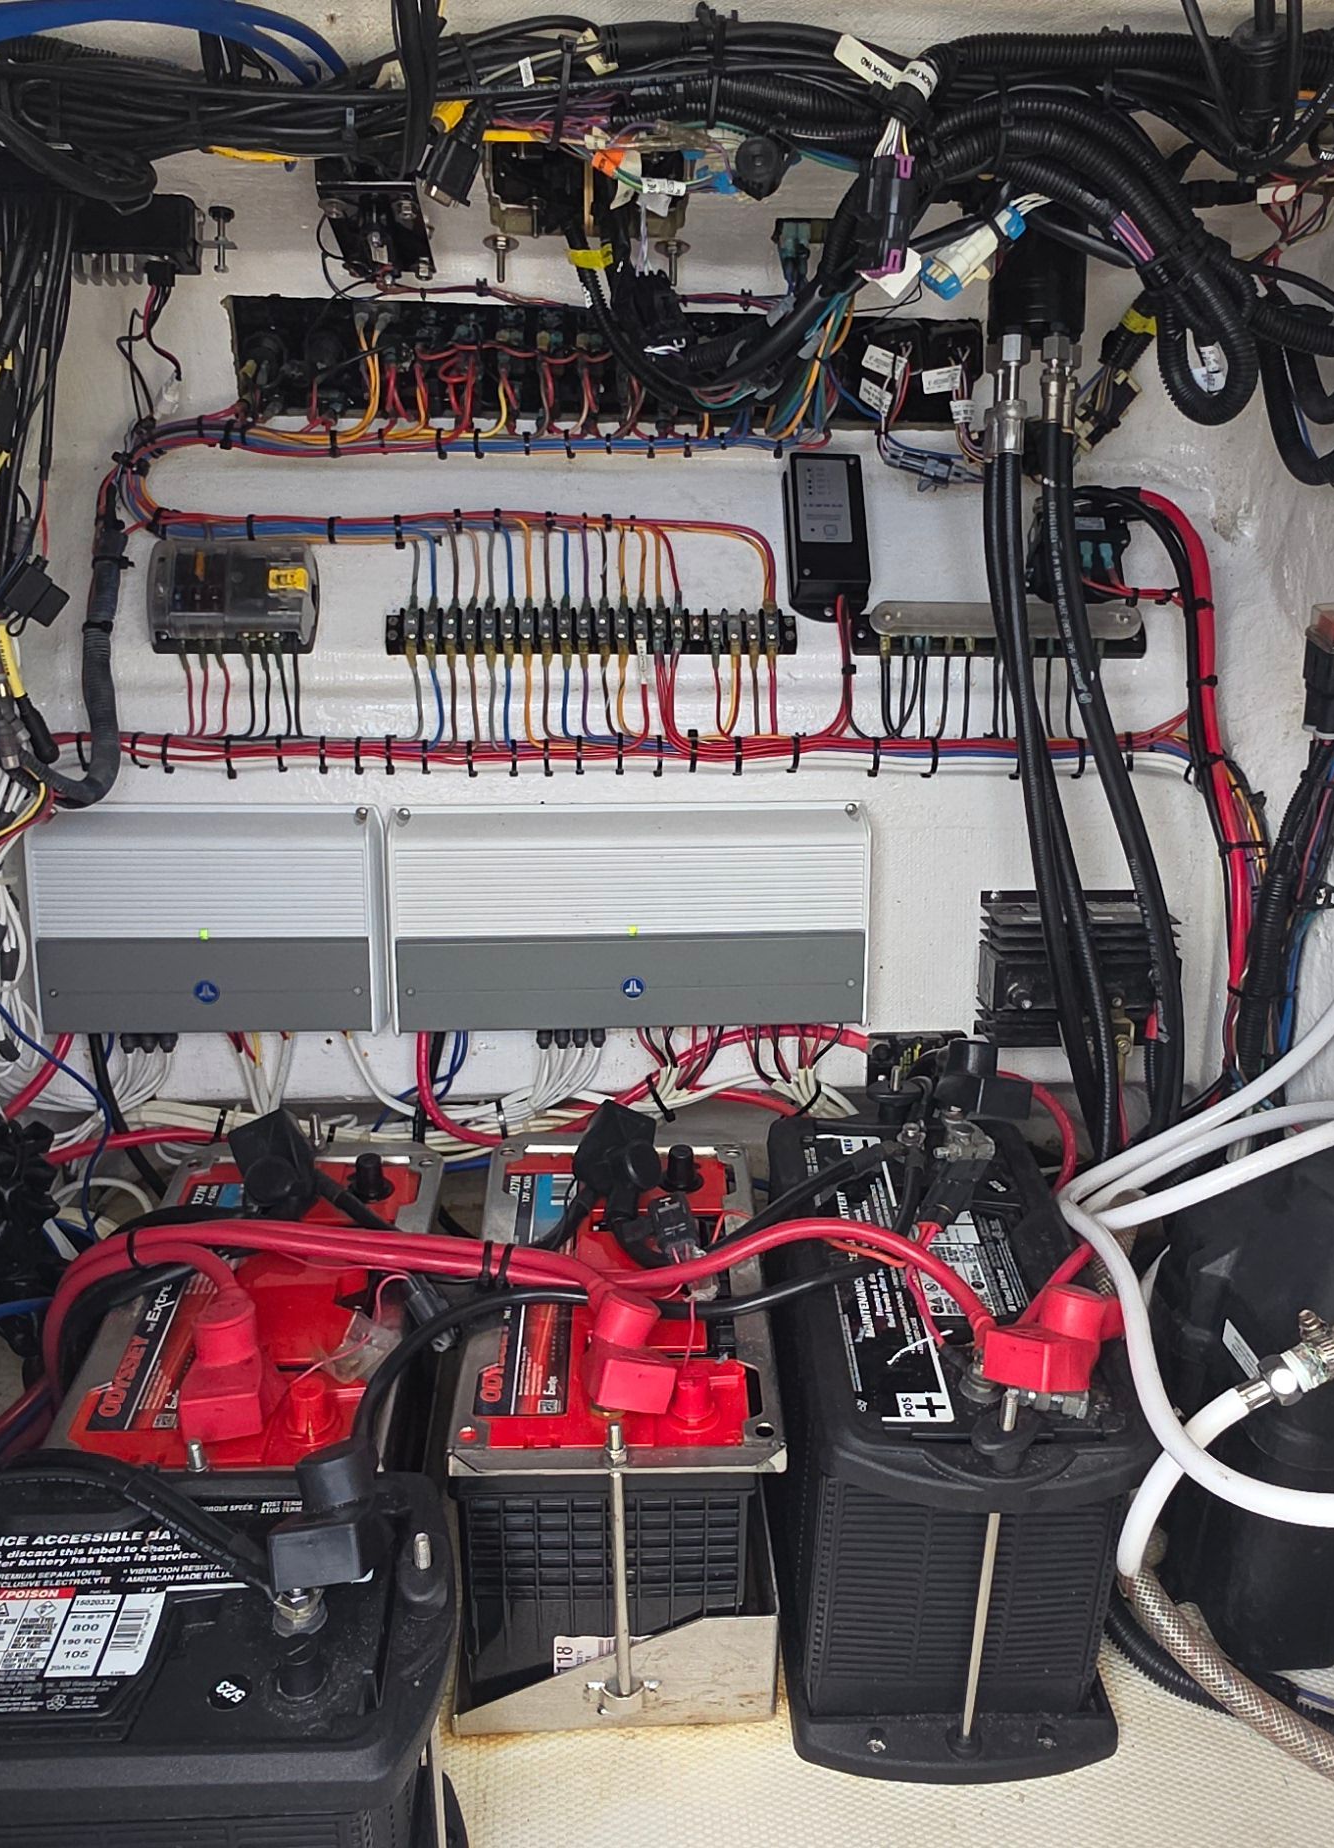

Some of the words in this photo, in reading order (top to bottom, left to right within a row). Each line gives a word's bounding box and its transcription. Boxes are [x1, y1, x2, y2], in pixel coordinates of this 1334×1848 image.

[901, 1397, 915, 1417] POS
[32, 1530, 144, 1546] ACCESSIBLE
[6, 1547, 56, 1558] discard
[59, 1546, 84, 1555] this
[88, 1544, 121, 1555] label
[124, 1544, 138, 1553] to
[141, 1542, 182, 1553] check
[18, 1555, 67, 1567] battery
[70, 1555, 94, 1565] has
[97, 1553, 131, 1563] been
[133, 1552, 147, 1562] in
[38, 1569, 102, 1579] SEPARATORS
[129, 1566, 180, 1575] VIBRATION
[43, 1576, 112, 1587] ELECTROLYTE
[125, 1574, 175, 1584] AMERICAN
[72, 1623, 99, 1632] 800
[64, 1650, 89, 1659] 105
[216, 1680, 246, 1703] 5/23
